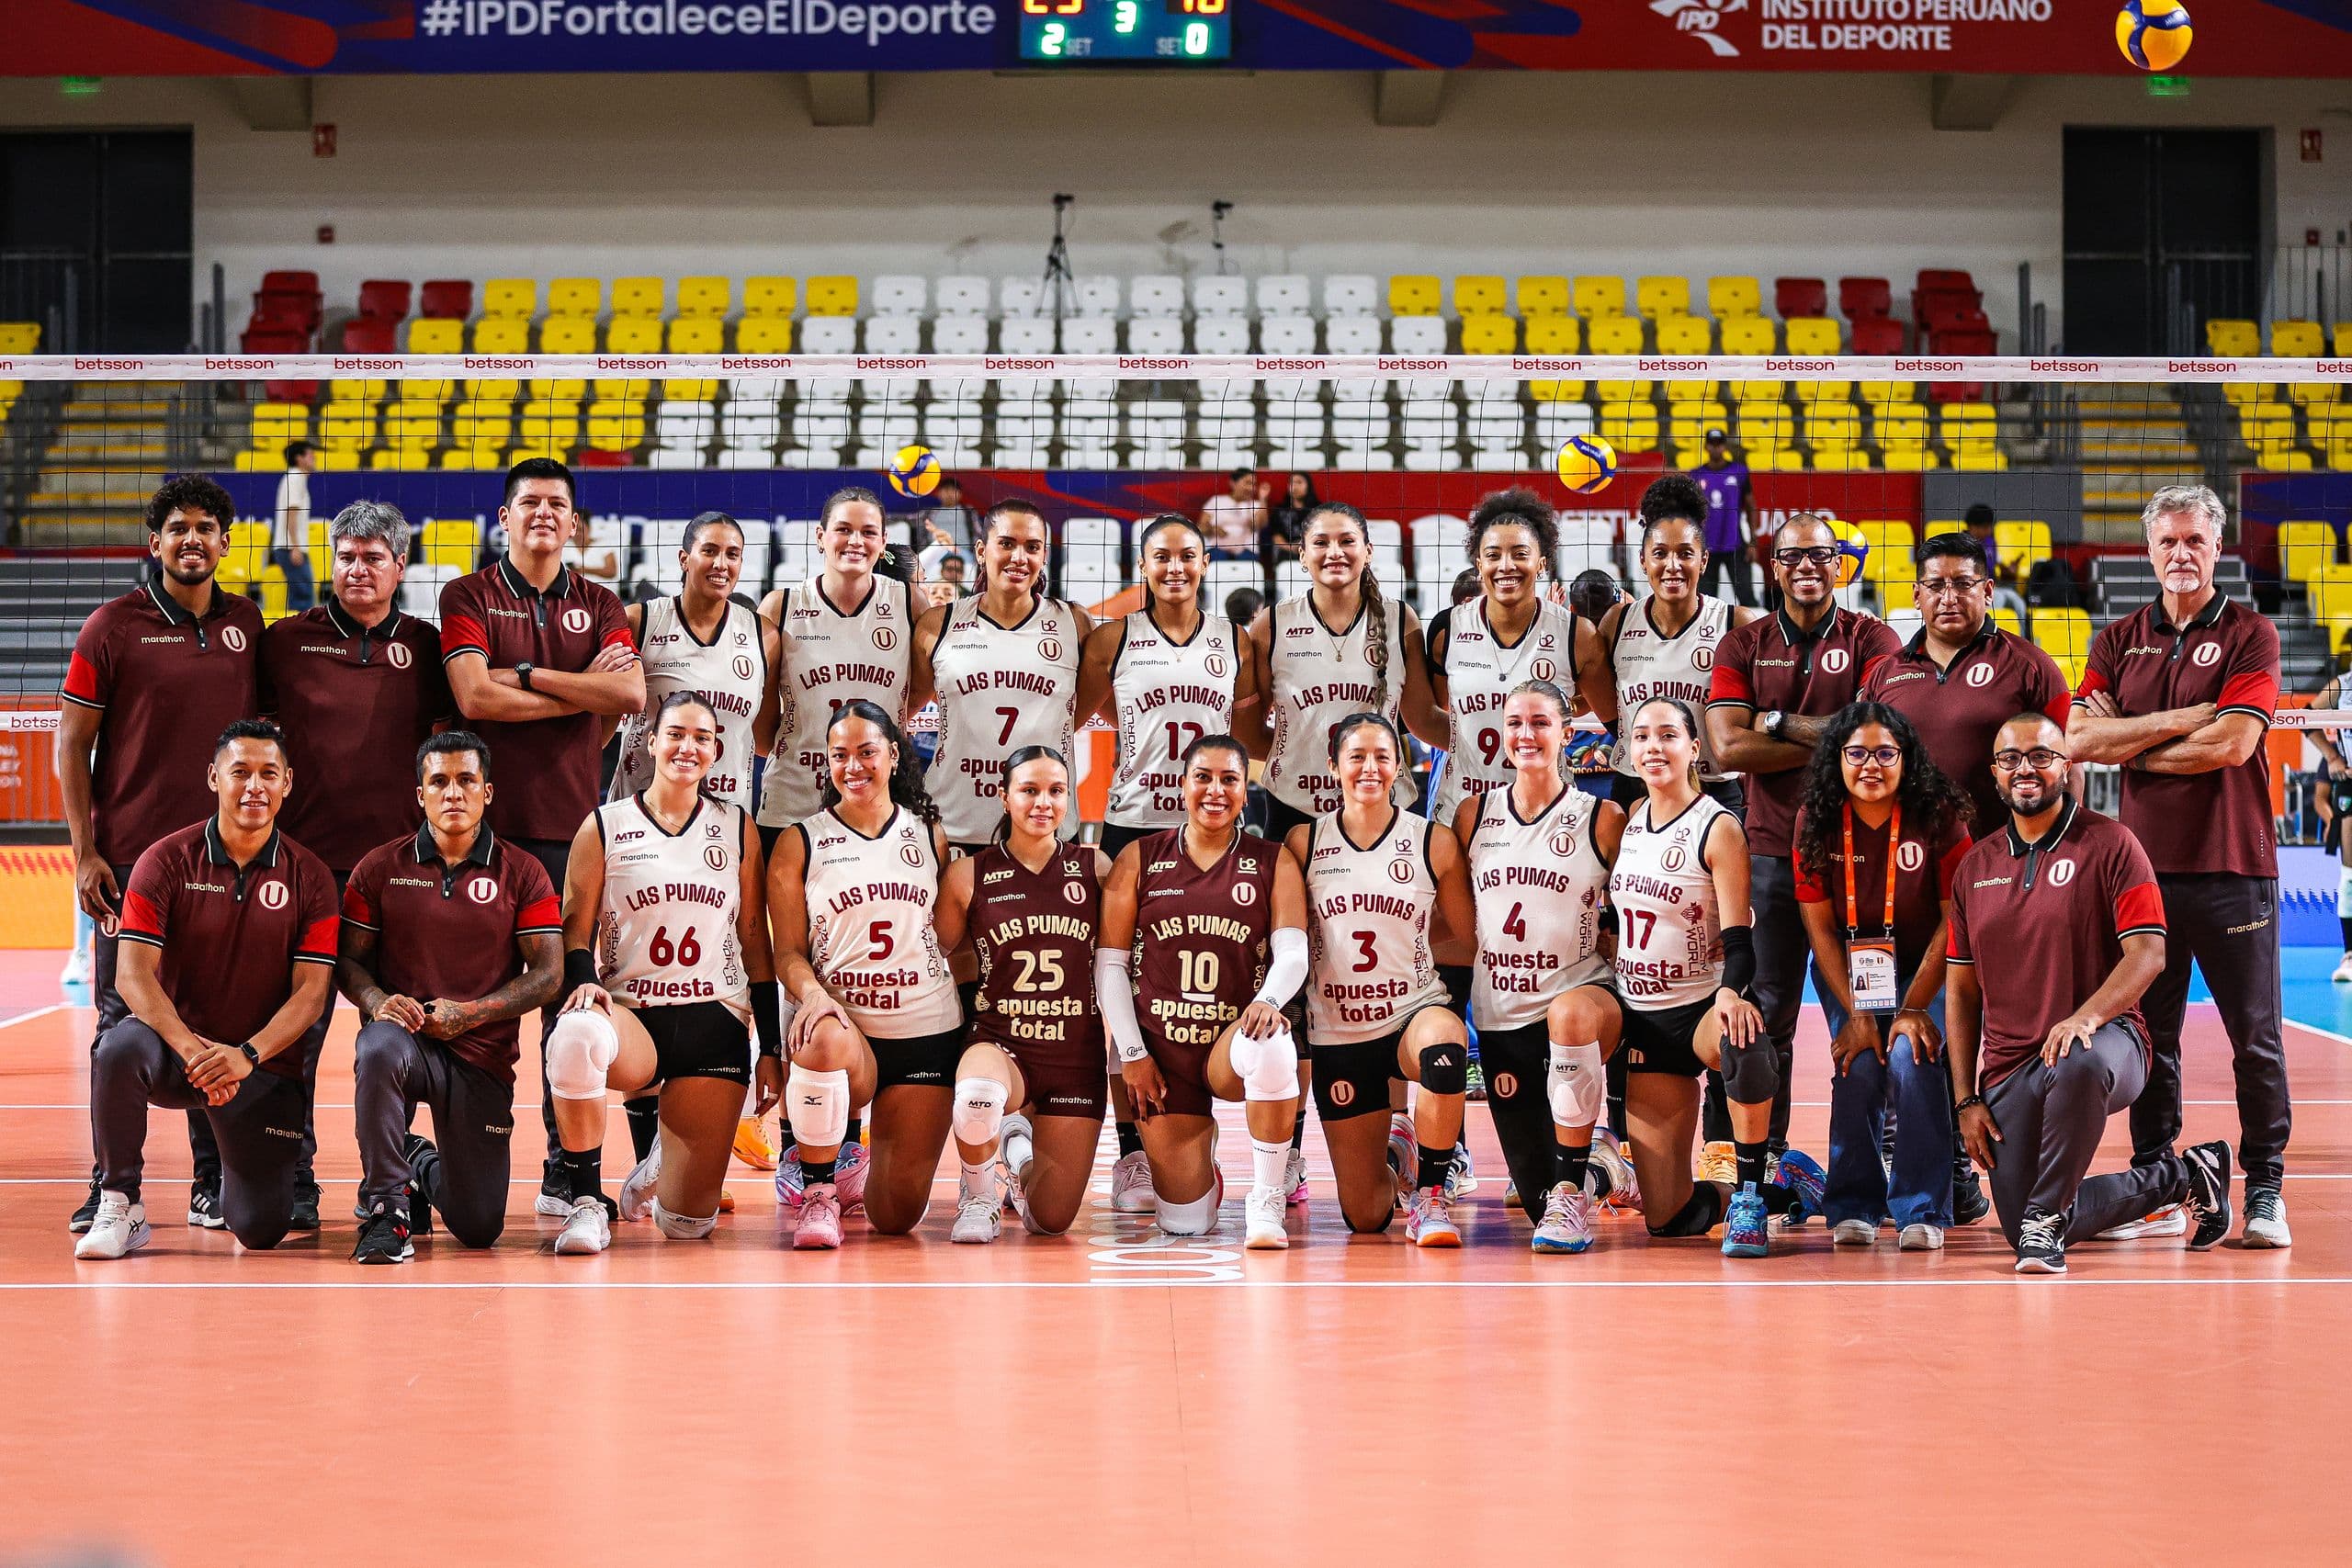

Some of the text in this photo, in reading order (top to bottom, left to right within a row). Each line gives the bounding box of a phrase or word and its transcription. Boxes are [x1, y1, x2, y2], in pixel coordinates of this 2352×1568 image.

[1114, 0, 1136, 32] 3
[1761, 0, 2052, 21] INSTITUTO PERUANO
[421, 0, 996, 46] #IPDFortaleceElDeporte
[1041, 23, 1065, 55] 2
[1184, 23, 1209, 55] 0
[1762, 26, 1952, 51] DEL DEPORTE
[75, 358, 2352, 373] betsson betsson betsson betsson betsson betsson betsson betsson betsson betsson betsson betsson betsson betsson betsson betsson betsson bets
[488, 607, 529, 619] marathon
[792, 609, 820, 619] MTD
[141, 636, 186, 645] marathon
[650, 635, 679, 644] MTD
[796, 634, 831, 642] marathon
[1286, 627, 1315, 637] MTD
[1456, 633, 1484, 642] MTD
[300, 645, 347, 656] marathon
[1128, 639, 1157, 649] MTD
[1458, 660, 1492, 670] marathon
[799, 663, 896, 691] LAS PUMAS
[956, 671, 1056, 696] LAS PUMAS
[1885, 671, 1926, 684] marathon
[1136, 685, 1227, 715] LAS PUMAS
[1293, 683, 1378, 711] LAS PUMA
[1622, 681, 1712, 706] LAS PUMAS
[1458, 694, 1487, 715] LAS
[11, 716, 62, 728] betss
[909, 717, 940, 728] etss
[995, 706, 1020, 746] 7
[2269, 716, 2306, 725] sson
[1165, 721, 1204, 761] 12
[1480, 818, 1505, 829] MTD
[615, 830, 643, 841] MTD
[818, 835, 846, 848] MTD
[620, 852, 659, 862] marathon
[822, 855, 860, 866] marathon
[1313, 846, 1340, 858] MTD
[983, 870, 1014, 883] MTD
[1315, 866, 1351, 876] marathon
[1476, 866, 1570, 894] LAS PUMAS
[1973, 875, 2012, 888] marathon
[390, 877, 435, 888] marathon
[1148, 888, 1184, 897] marathon
[1625, 874, 1683, 904] PUMAS
[626, 883, 726, 912] LAS PUMAS
[828, 883, 929, 915] LAS PUMAS
[988, 892, 1026, 905] marathon
[1318, 894, 1415, 920] LAS PUMAS
[989, 915, 1091, 946] LAS PUMAS
[1150, 915, 1251, 944] LAS PUMAS
[1502, 901, 1526, 942] 4
[1623, 908, 1658, 951] 17
[2227, 919, 2269, 934] marathon
[649, 925, 702, 967] 66
[868, 920, 894, 961] 5
[1351, 931, 1378, 973] 3
[1482, 950, 1560, 972] apuesta
[831, 968, 920, 989] apuesta
[1012, 949, 1065, 993] 25
[1178, 949, 1219, 993] 10
[626, 978, 715, 999] apuesta
[1323, 978, 1408, 1003] apuesta
[1491, 972, 1541, 993] total
[1625, 976, 1673, 996] total
[846, 989, 900, 1010] total
[996, 996, 1083, 1020] apuesta
[1150, 998, 1238, 1022] apuesta
[1340, 1001, 1394, 1023] total
[1010, 1019, 1066, 1041] total
[1164, 1023, 1219, 1044] total
[1555, 1064, 1578, 1072] MTD
[968, 1100, 992, 1109] MTD
[1050, 1097, 1092, 1106] marathon
